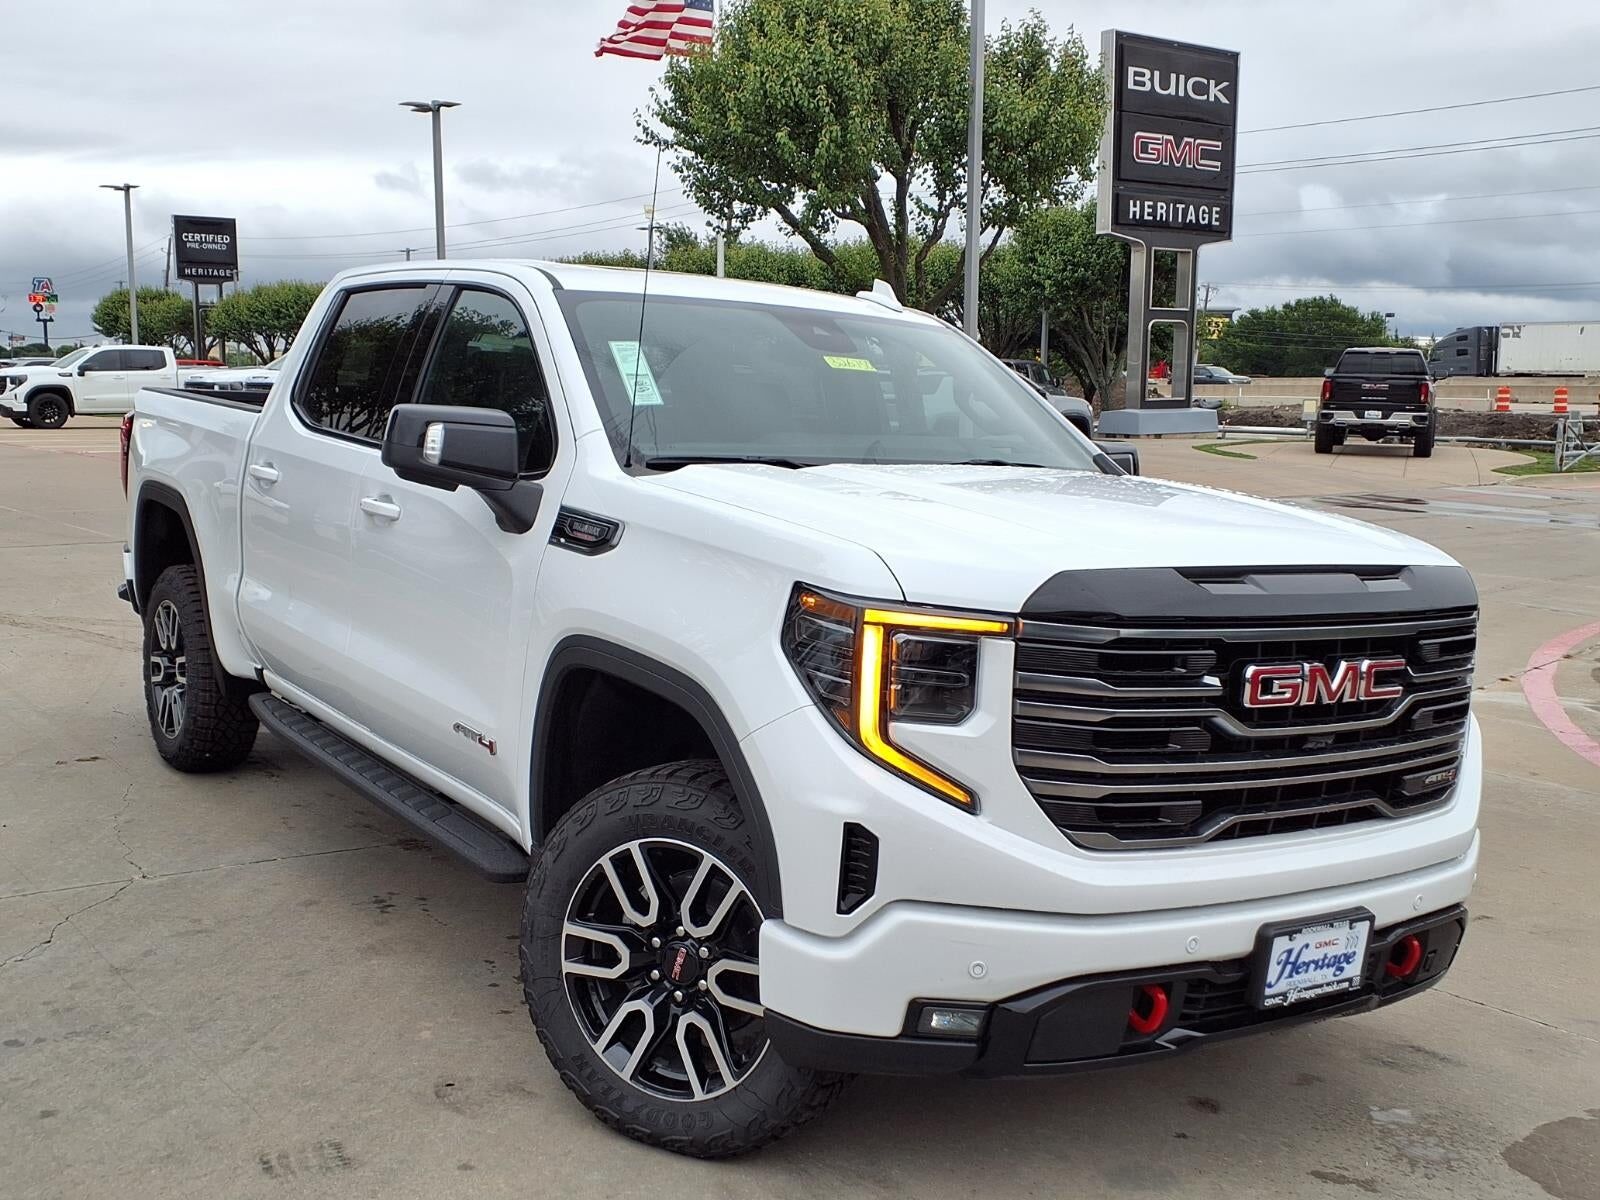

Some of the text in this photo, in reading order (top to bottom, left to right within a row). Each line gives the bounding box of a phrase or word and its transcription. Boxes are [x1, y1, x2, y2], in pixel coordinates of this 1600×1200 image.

[1127, 66, 1230, 104] BUICK
[1133, 131, 1222, 172] GMC
[1129, 200, 1220, 226] HERITAGE
[182, 233, 230, 243] CERTIFIED
[186, 242, 227, 250] PRE-OWNED
[184, 267, 232, 277] HERITAGE
[33, 278, 53, 293] TA
[1243, 658, 1406, 708] GMC
[1315, 938, 1340, 949] GMC
[671, 947, 687, 981] GMC
[1265, 942, 1357, 989] Heritage
